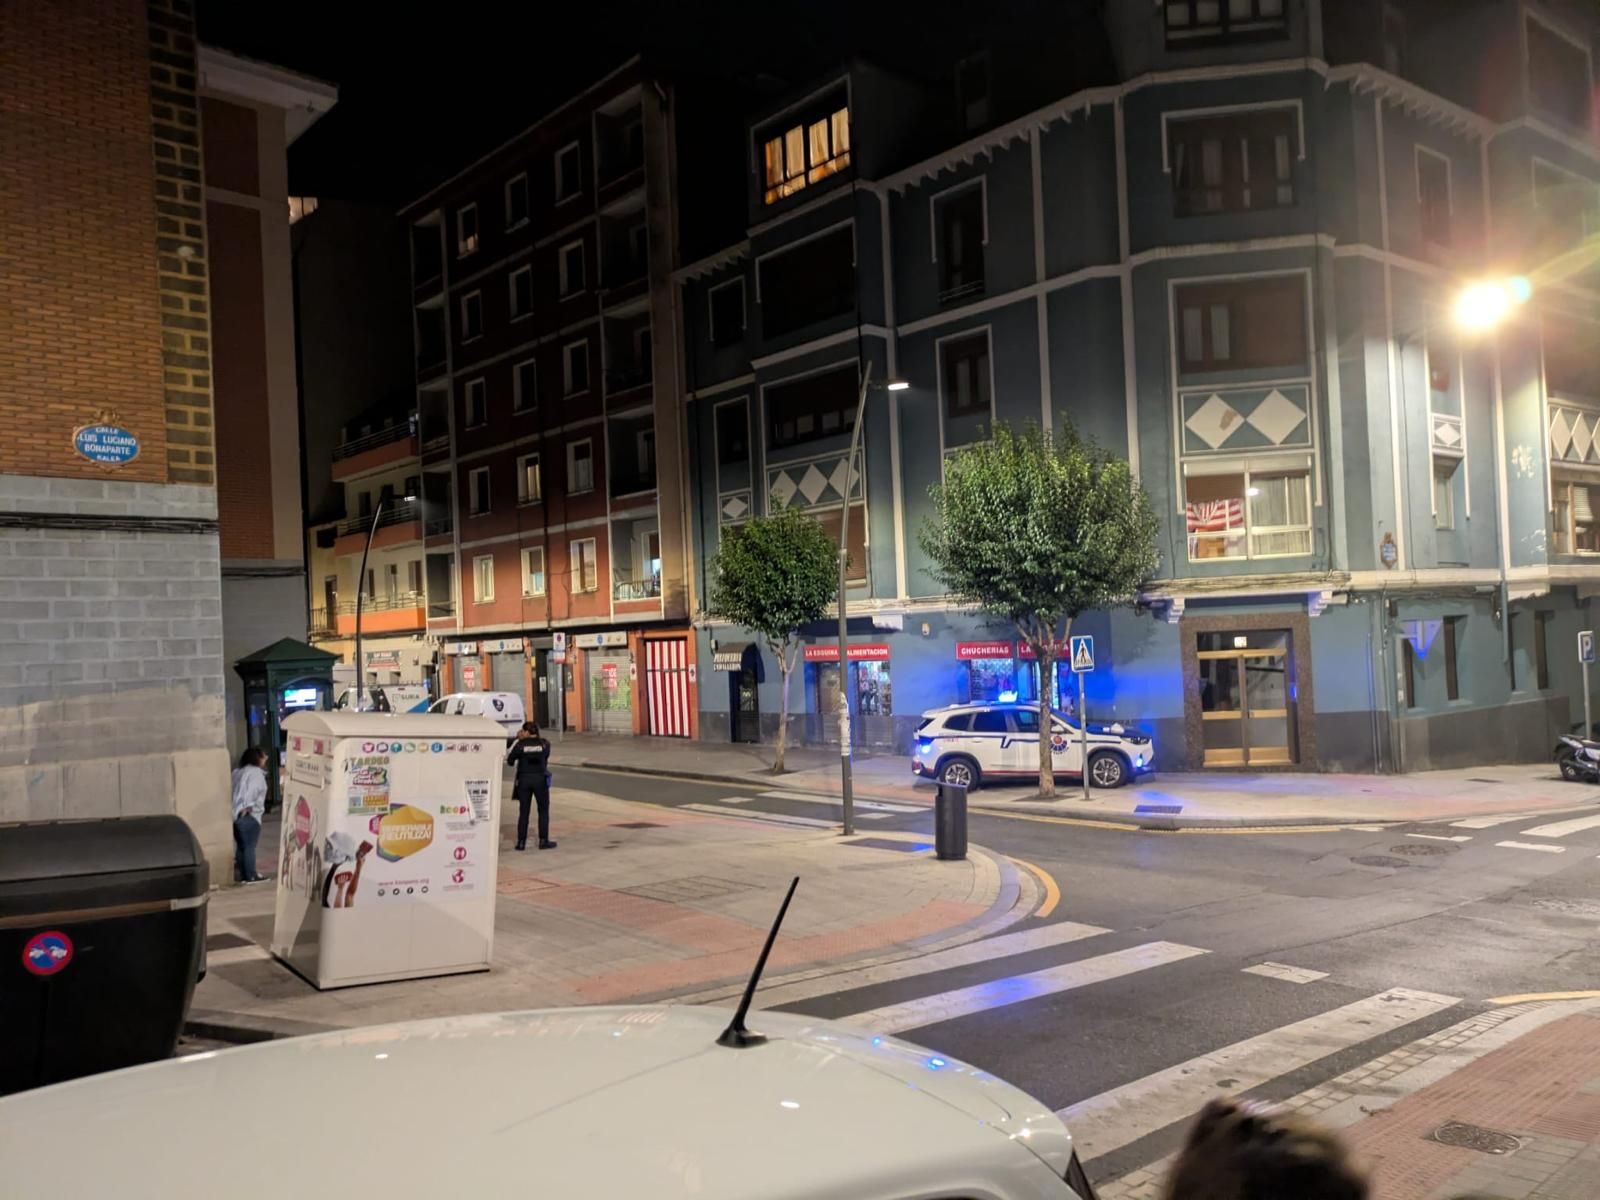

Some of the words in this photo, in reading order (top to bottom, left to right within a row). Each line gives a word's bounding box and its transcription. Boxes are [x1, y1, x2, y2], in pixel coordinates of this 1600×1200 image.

[80, 433, 97, 442] LUIS
[103, 435, 136, 446] LUCIANO
[84, 444, 131, 455] BONAPARTE
[805, 649, 813, 657] LA
[814, 648, 839, 657] ESQUINA
[961, 646, 1009, 655] CHUCHERIAS
[1021, 645, 1031, 653] LA
